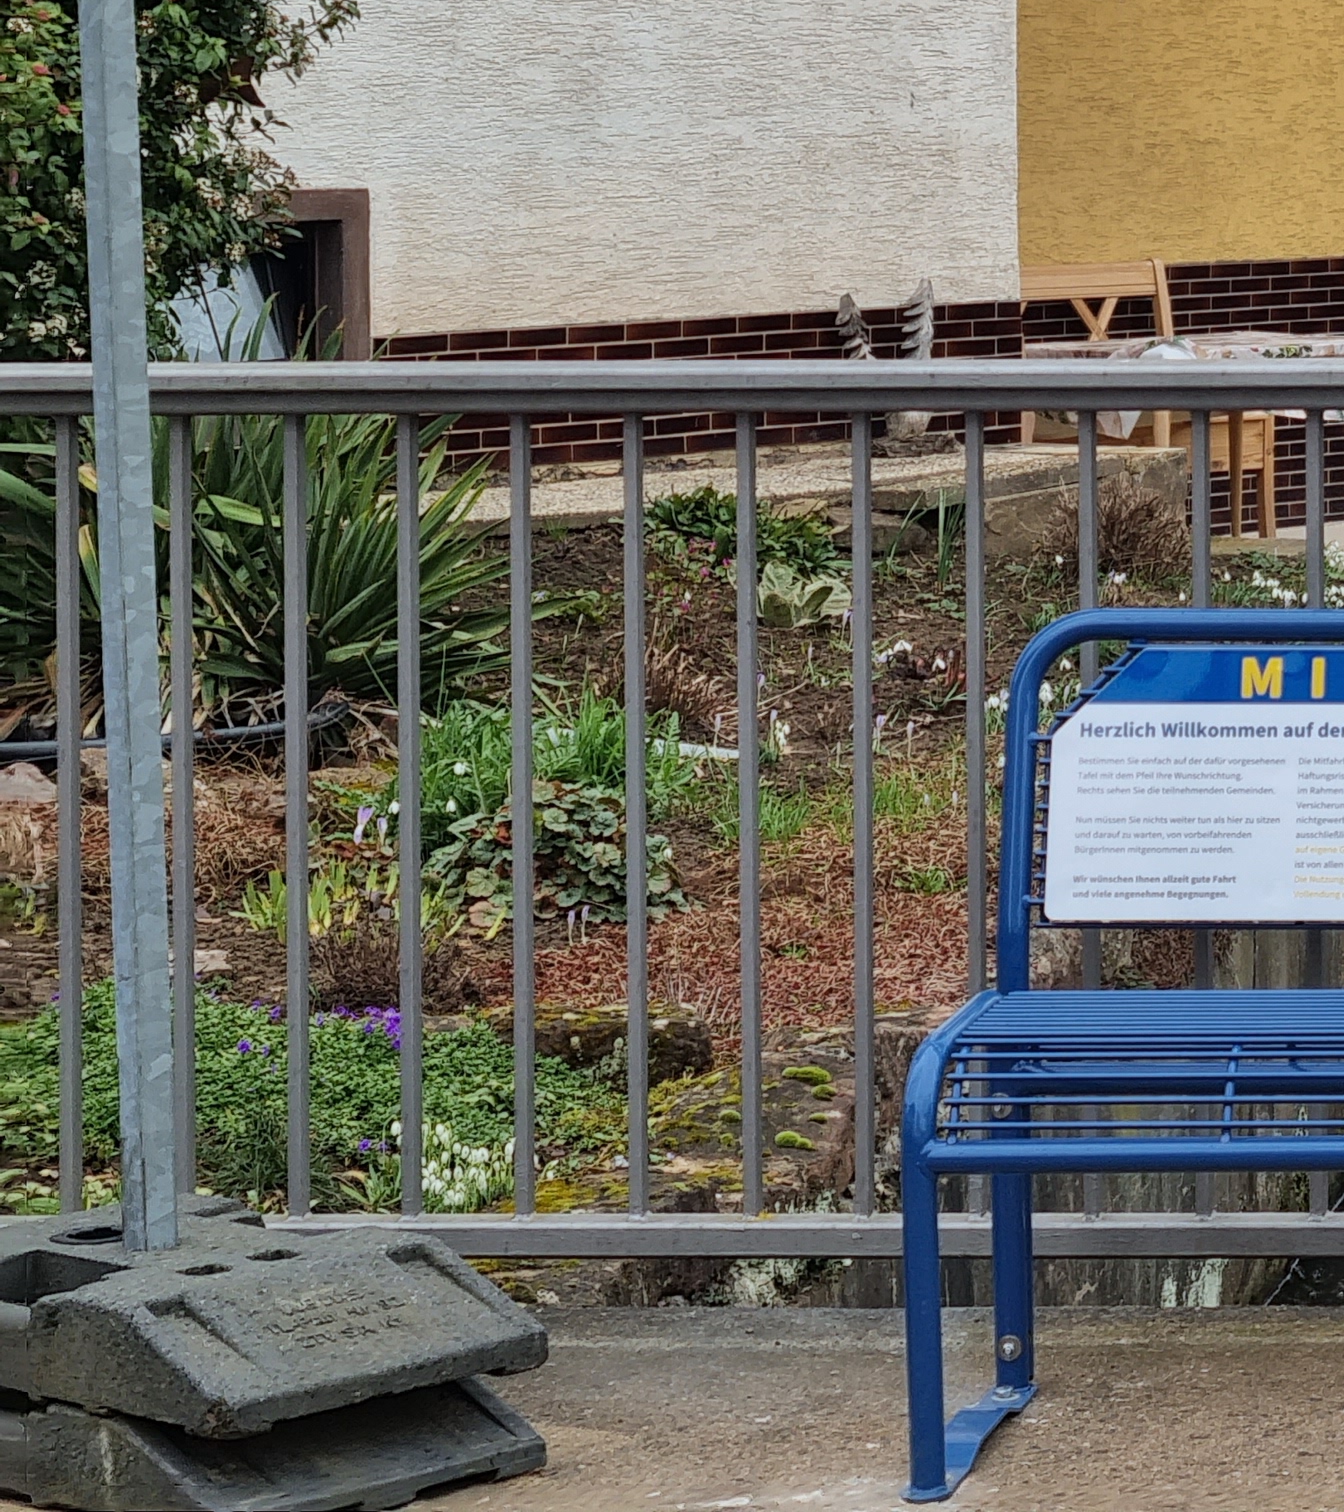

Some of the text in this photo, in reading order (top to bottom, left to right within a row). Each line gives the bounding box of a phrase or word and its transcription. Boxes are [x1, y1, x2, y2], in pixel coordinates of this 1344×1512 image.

[1080, 722, 1156, 738] Herzlich
[1161, 722, 1278, 738] Willkommen
[1284, 722, 1314, 738] auf
[1078, 757, 1286, 767] Bestimmen Sie einfach auf der dafür vorgesehenen
[1298, 757, 1312, 765] Die
[1078, 772, 1243, 782] Tafel mit dem Pfeil Ihre Wunschrichtung.
[1077, 787, 1275, 795] Rechts sehen Sie die teilnehmenden Gemeinden.
[1297, 787, 1308, 795] im
[1310, 787, 1344, 795] Rahmen
[1076, 816, 1092, 824] Nun
[1094, 816, 1126, 824] müssen
[1128, 816, 1141, 824] Sie
[1143, 816, 1168, 824] nichts
[1170, 816, 1196, 824] weiter
[1198, 816, 1212, 824] tun
[1213, 816, 1225, 824] als
[1227, 816, 1243, 824] hier
[1256, 816, 1280, 824] sitzen
[1075, 831, 1091, 839] und
[1093, 831, 1120, 839] darauf
[1133, 831, 1164, 841] warten,
[1184, 831, 1252, 839] vorbeifahrenden
[1074, 846, 1125, 856] BürgerInnen
[1127, 846, 1188, 856] mitgenommen
[1201, 846, 1234, 854] werden.
[1294, 861, 1304, 869] ist
[1324, 861, 1344, 869] allen
[1073, 875, 1236, 886] Wir wünschen Ihnen allzeit gute Fahrt
[1072, 890, 1228, 900] und viele angenehme Begegnungen.
